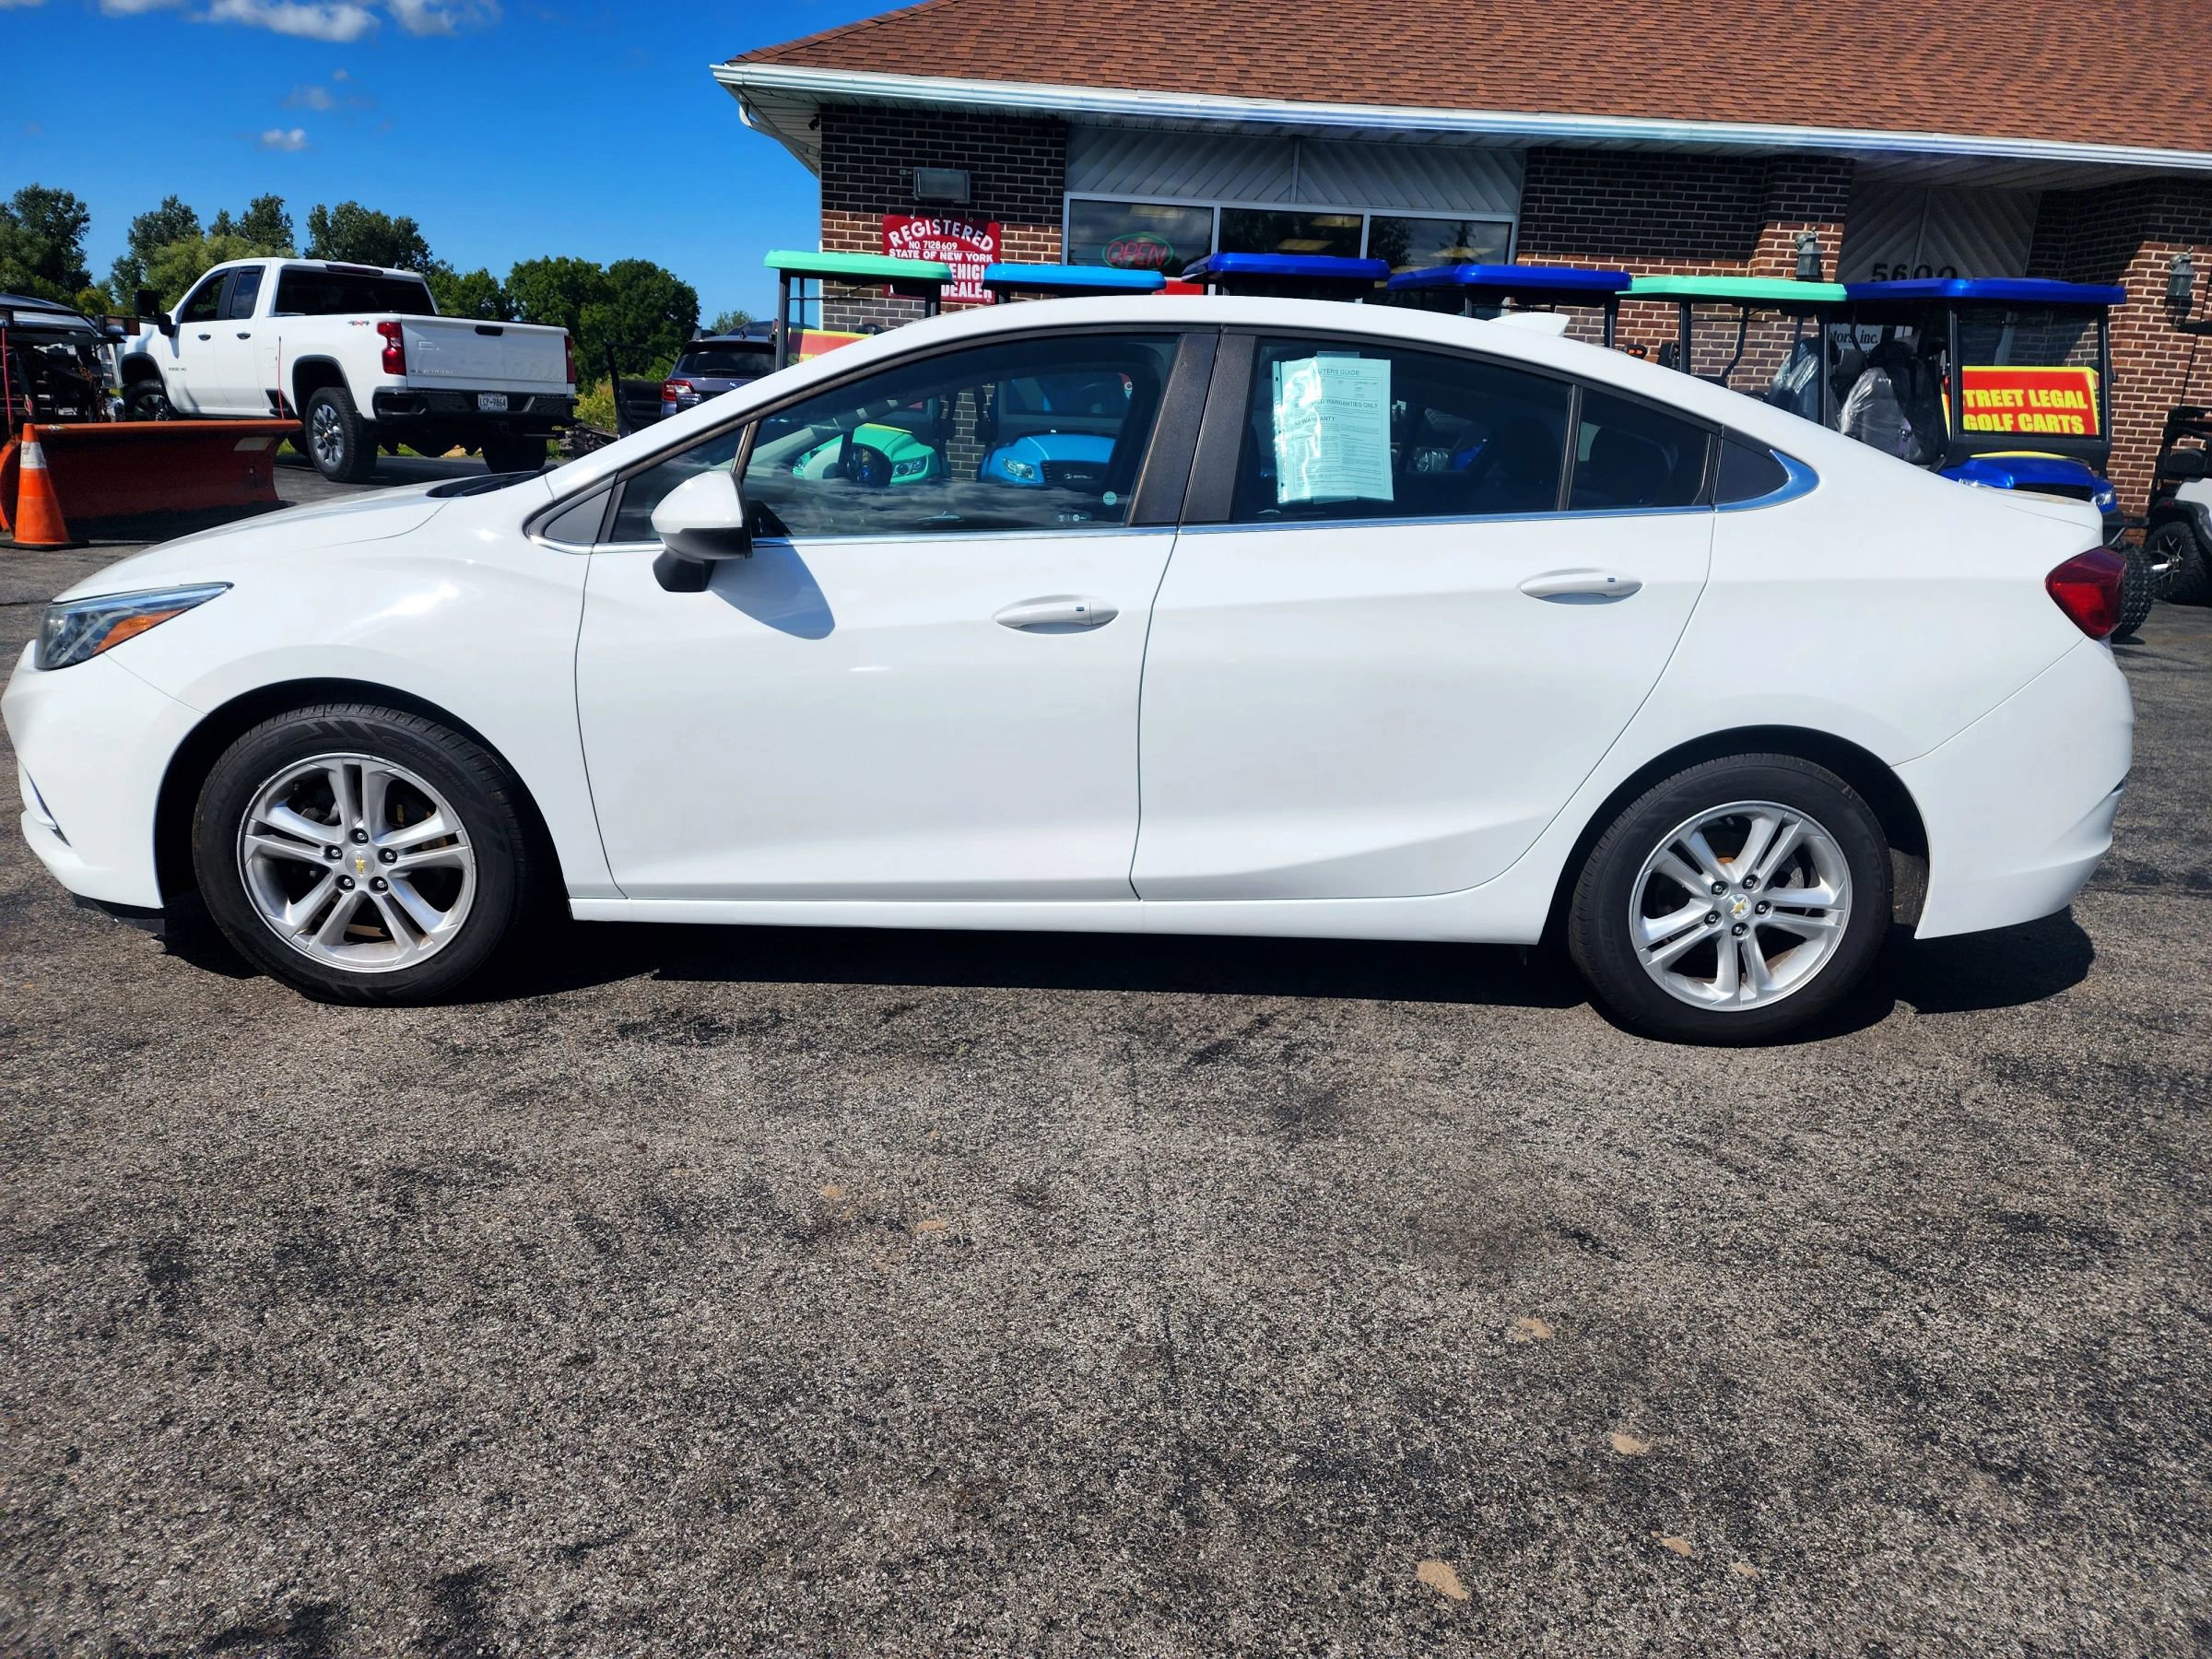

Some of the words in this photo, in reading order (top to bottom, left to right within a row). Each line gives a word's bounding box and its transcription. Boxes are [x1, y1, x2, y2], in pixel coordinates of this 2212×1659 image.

[888, 218, 994, 251] REGISTERED
[888, 248, 920, 258] STATE
[923, 251, 937, 259] OF
[939, 252, 962, 261] NEW
[966, 253, 994, 262] YORK
[924, 240, 958, 250] 7128609
[1107, 241, 1168, 266] OPEN
[1859, 330, 1878, 344] inc.
[1963, 389, 2024, 408] TREET
[2029, 390, 2088, 409] LEGAL
[1963, 413, 2014, 432] GOLF
[2018, 413, 2085, 435] CARTS
